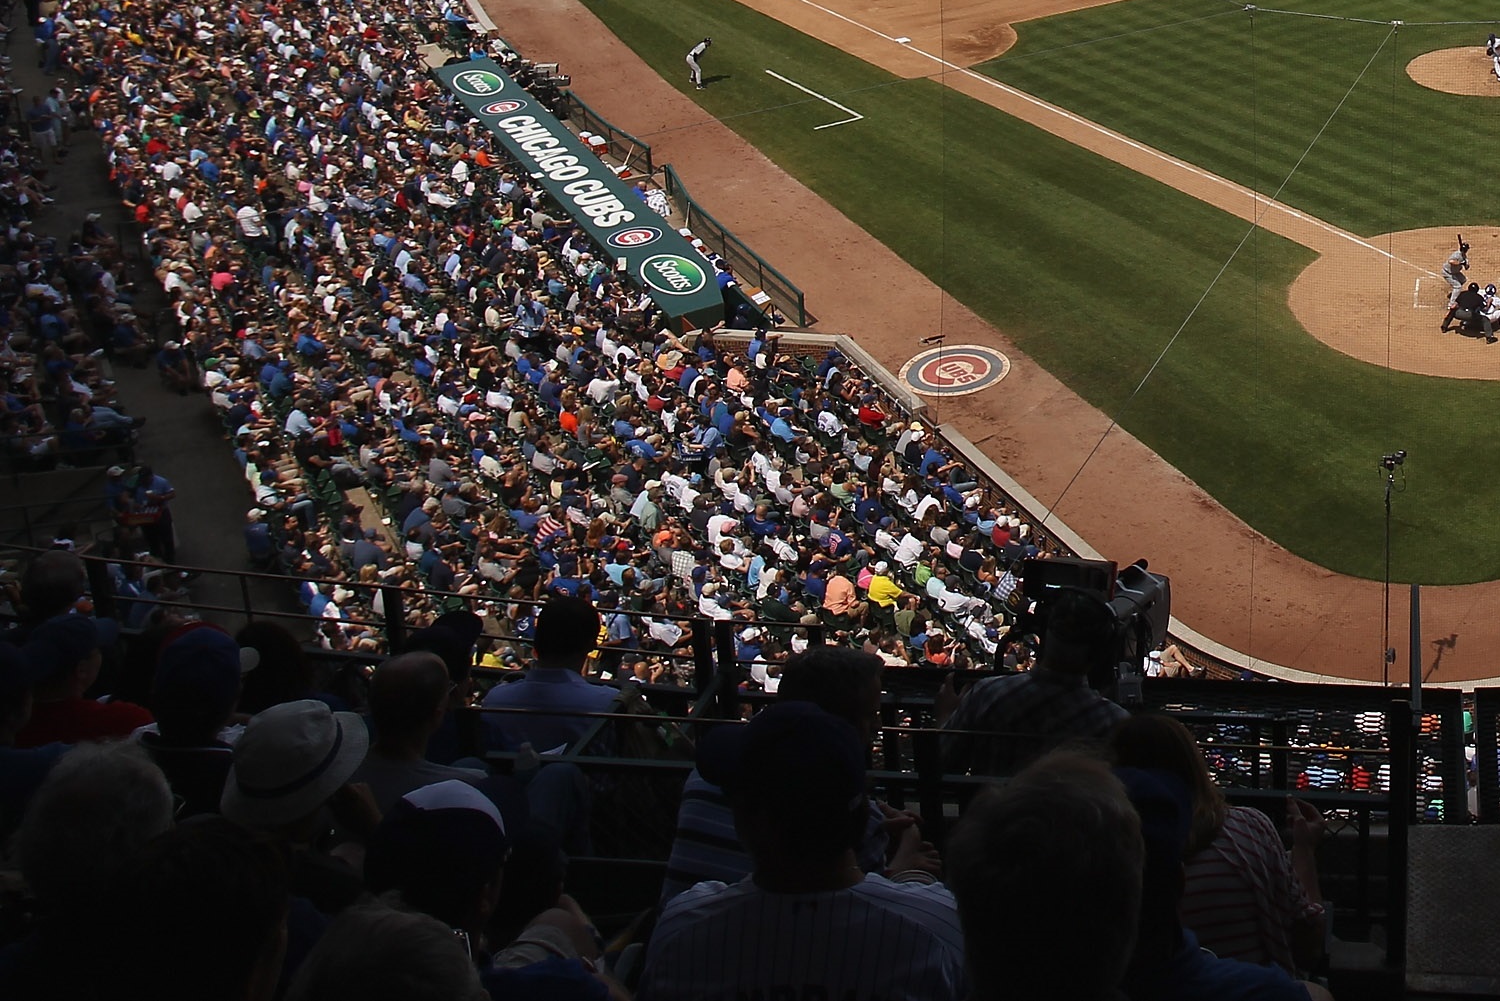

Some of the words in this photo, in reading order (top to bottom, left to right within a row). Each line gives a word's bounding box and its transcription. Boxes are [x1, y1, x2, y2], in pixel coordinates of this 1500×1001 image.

[498, 115, 589, 181] CHICAGO
[563, 179, 635, 227] CUBS
[651, 260, 692, 291] Scotts
